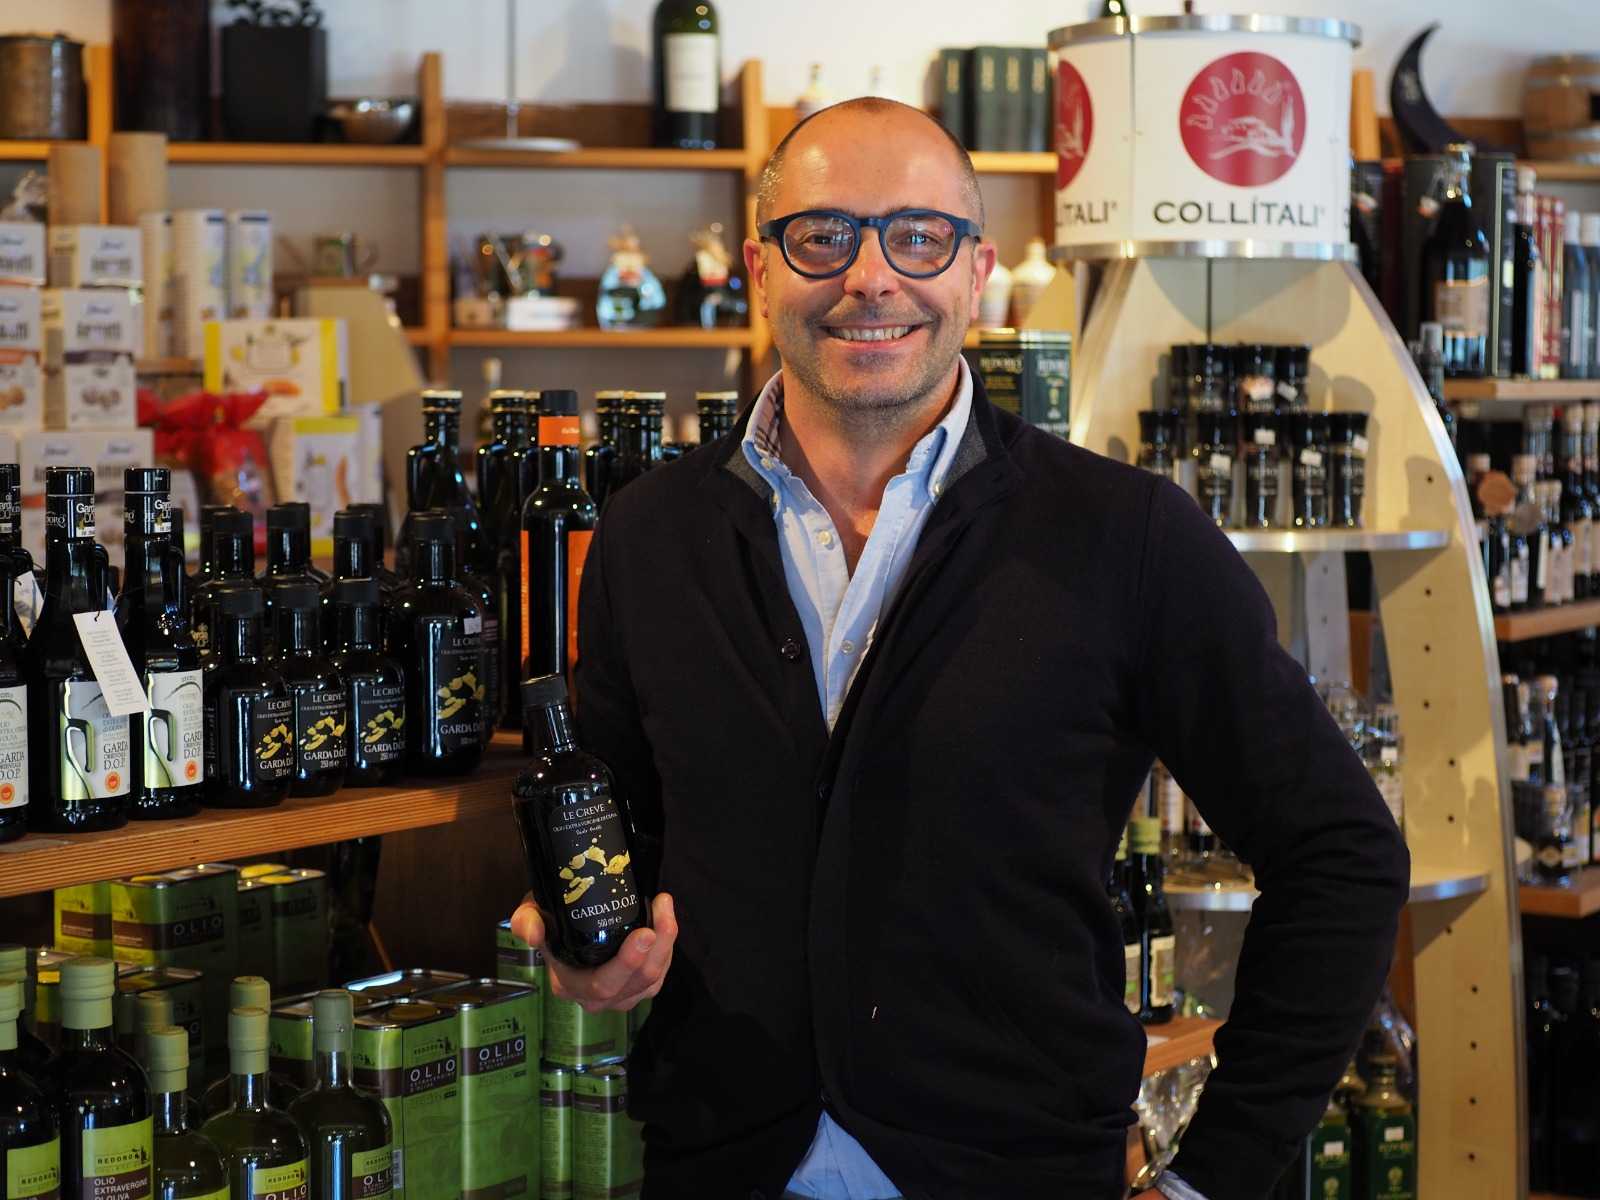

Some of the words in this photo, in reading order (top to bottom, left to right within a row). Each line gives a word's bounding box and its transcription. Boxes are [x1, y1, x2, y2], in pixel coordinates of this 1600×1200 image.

[303, 750, 333, 761] GARDA
[563, 811, 576, 821] LE
[576, 803, 606, 818] CREVE
[571, 903, 611, 920] GARDA
[173, 915, 224, 936] OLIO
[479, 1039, 524, 1061] OLIO
[410, 1059, 455, 1082] OLIO
[94, 1176, 116, 1187] OLIO
